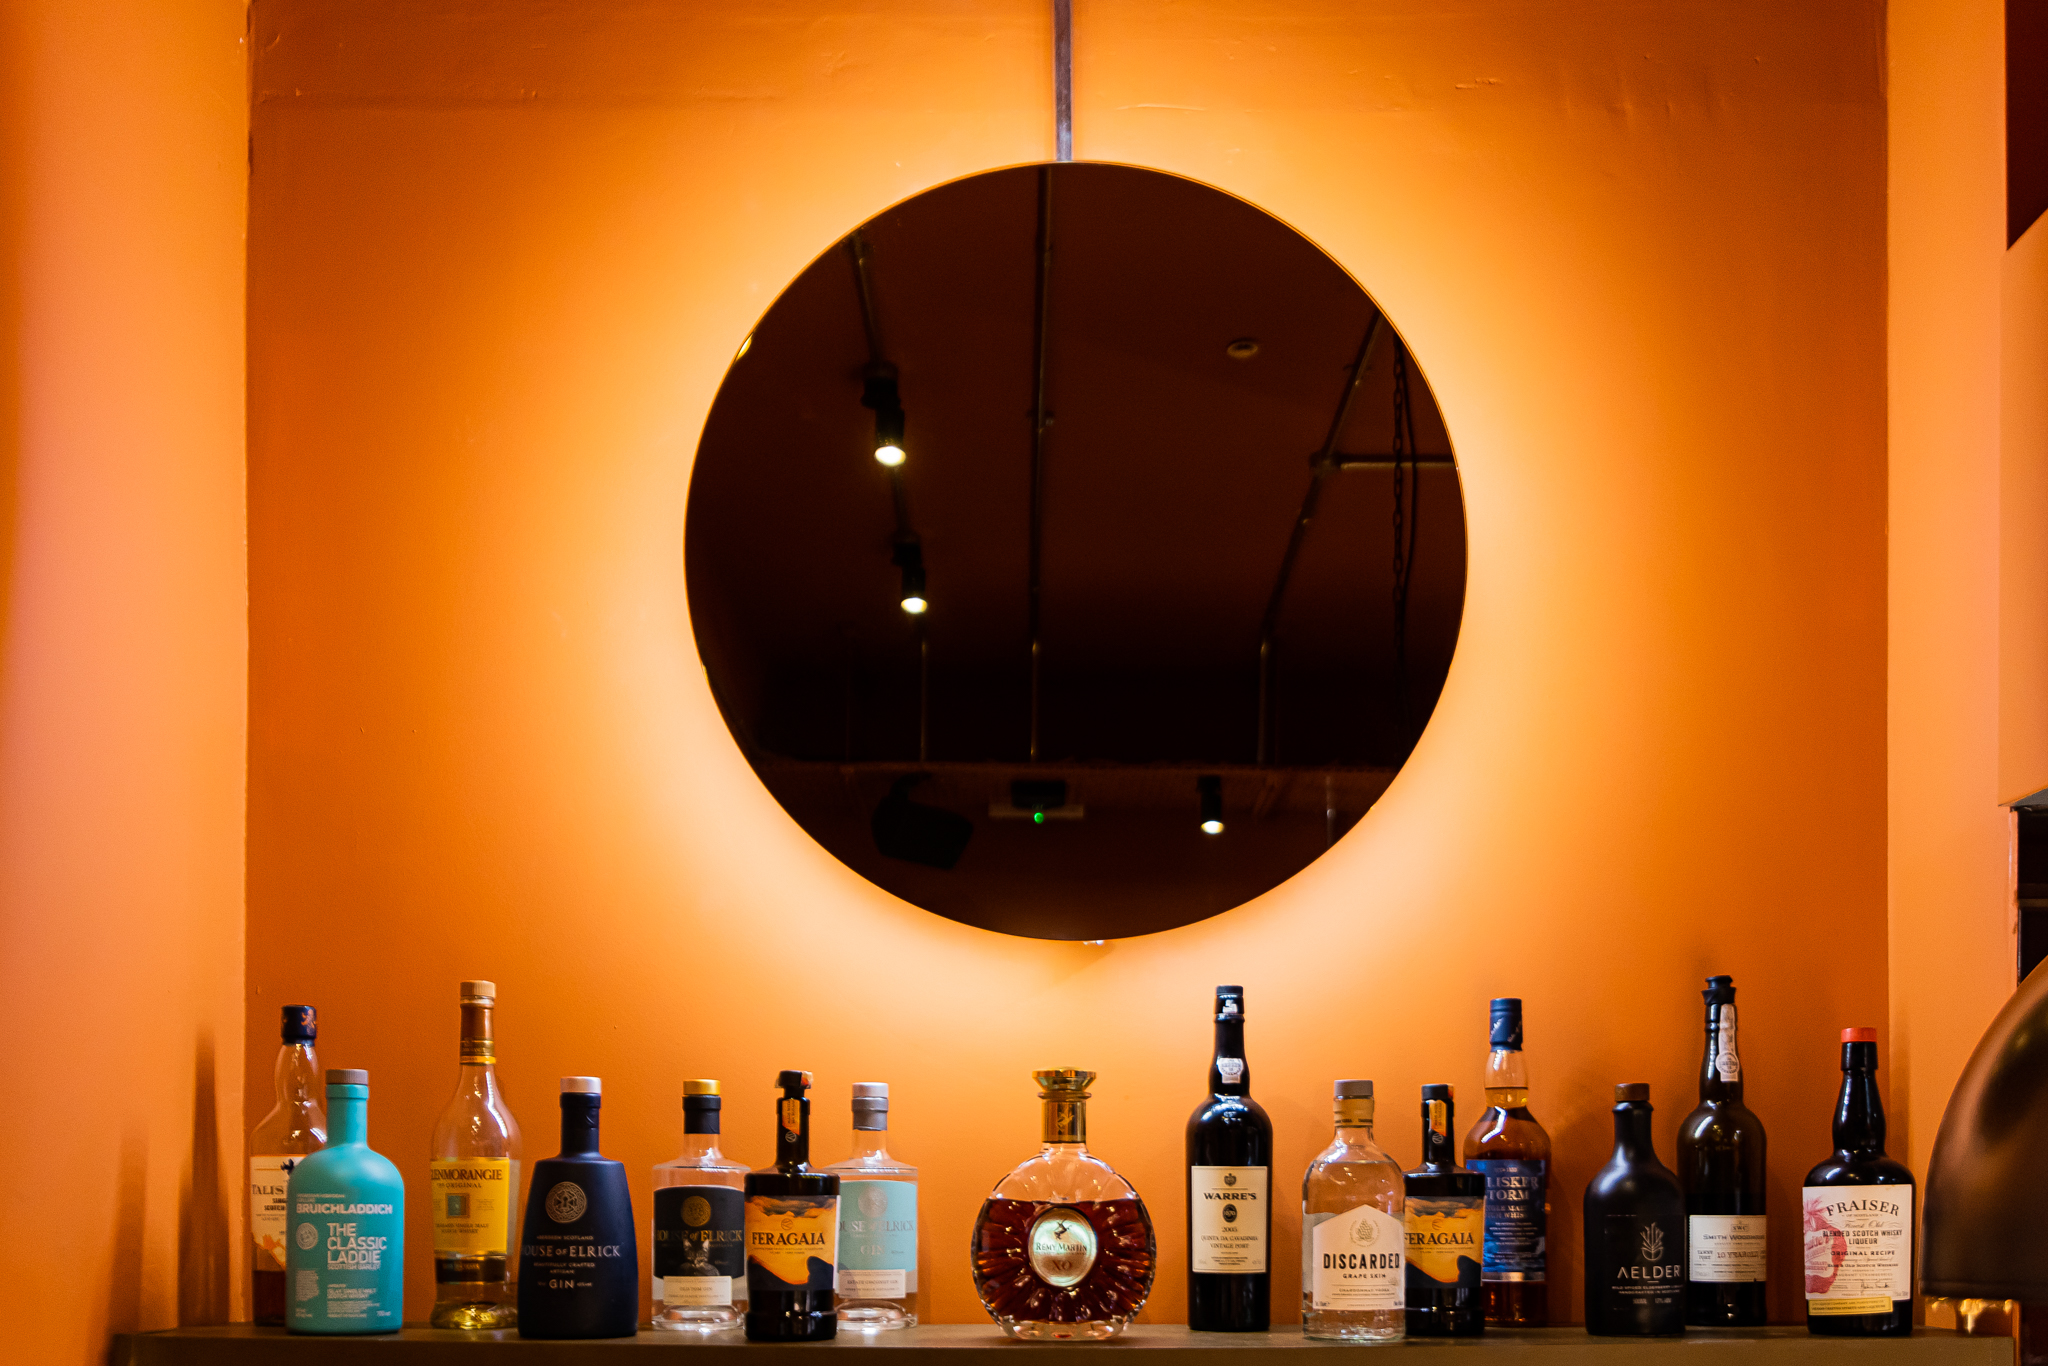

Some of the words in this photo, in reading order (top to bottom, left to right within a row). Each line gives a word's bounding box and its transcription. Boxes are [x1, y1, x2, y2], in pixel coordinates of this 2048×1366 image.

[1486, 1176, 1539, 1188] LISKER
[252, 1184, 284, 1195] TALIS
[1486, 1189, 1529, 1200] TORM
[1203, 1192, 1257, 1200] WARRE'S
[296, 1203, 394, 1215] BRUICHLADDICH
[1826, 1199, 1900, 1217] FRAISER
[326, 1223, 357, 1236] THE
[701, 1230, 743, 1242] ELRICK
[752, 1232, 826, 1245] FERAGAIA
[327, 1236, 388, 1250] CLASSIC
[1057, 1243, 1087, 1251] MARTIN
[327, 1250, 381, 1264] LADDIE
[523, 1245, 553, 1257] OUSE
[569, 1245, 621, 1257] ELRICK
[1052, 1260, 1072, 1271] XO
[1323, 1253, 1400, 1269] DISCARDED
[549, 1279, 575, 1289] GIN
